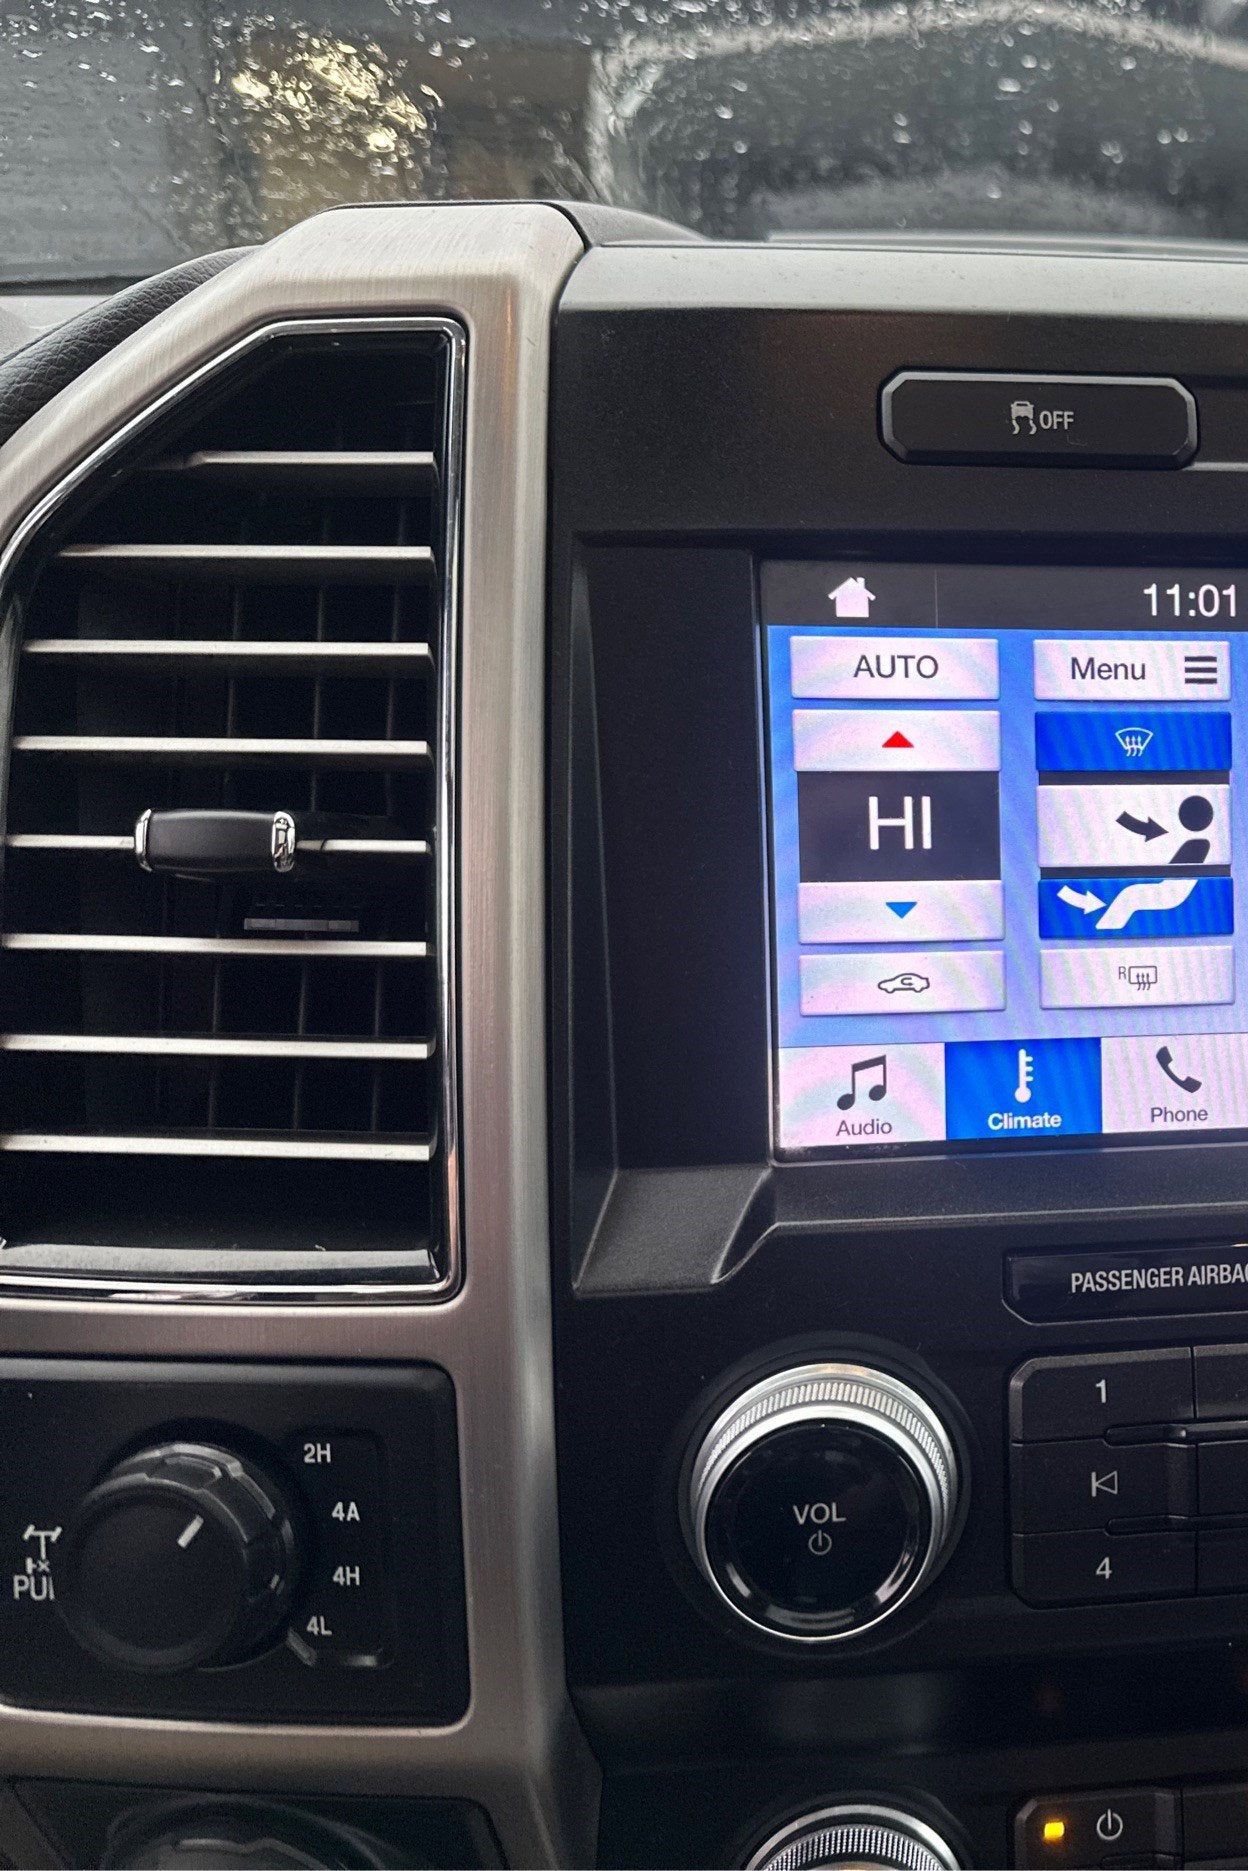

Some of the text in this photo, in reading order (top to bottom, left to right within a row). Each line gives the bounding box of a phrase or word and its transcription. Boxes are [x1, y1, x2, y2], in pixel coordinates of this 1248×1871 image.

[1040, 410, 1074, 430] OFF
[1143, 583, 1237, 617] 11:01
[853, 654, 939, 679] AUTO
[1070, 656, 1146, 681] Menu
[868, 795, 932, 850] HI
[1118, 966, 1127, 981] R
[987, 1111, 1062, 1131] Climate
[1150, 1105, 1209, 1124] Phone
[836, 1118, 893, 1138] Audio
[1070, 1266, 1185, 1293] PASSENGER
[1095, 1379, 1107, 1403] 1
[303, 1443, 332, 1463] 2H
[332, 1502, 361, 1522] 4A
[793, 1502, 847, 1525] VOL
[333, 1566, 361, 1586] 4H
[1095, 1556, 1113, 1580] 4
[306, 1615, 333, 1636] 4L
